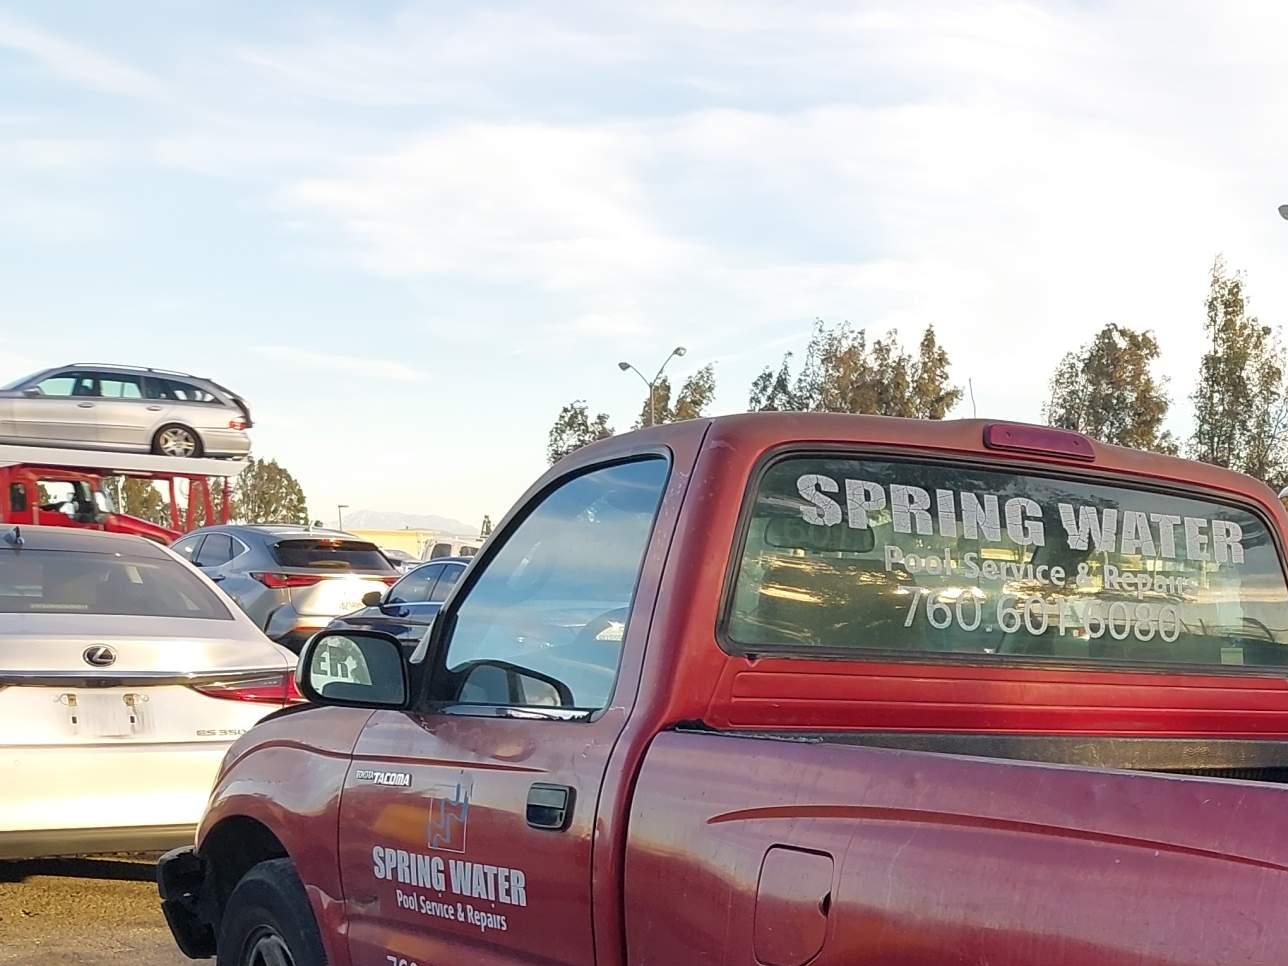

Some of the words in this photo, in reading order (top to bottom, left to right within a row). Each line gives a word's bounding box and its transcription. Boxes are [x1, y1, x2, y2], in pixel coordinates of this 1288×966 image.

[796, 473, 1045, 547] SPRING
[1058, 505, 1245, 564] WATER
[884, 545, 950, 577] Pool
[964, 551, 1066, 587] Service
[1076, 562, 1094, 587] &
[1103, 566, 1200, 599] Repairs
[374, 771, 411, 787] TACOMA
[372, 845, 445, 891] SPRING
[449, 859, 527, 907] WATER
[396, 889, 418, 909] Pool
[420, 898, 455, 920] Service
[457, 905, 465, 922] &
[467, 907, 508, 932] Repairs
